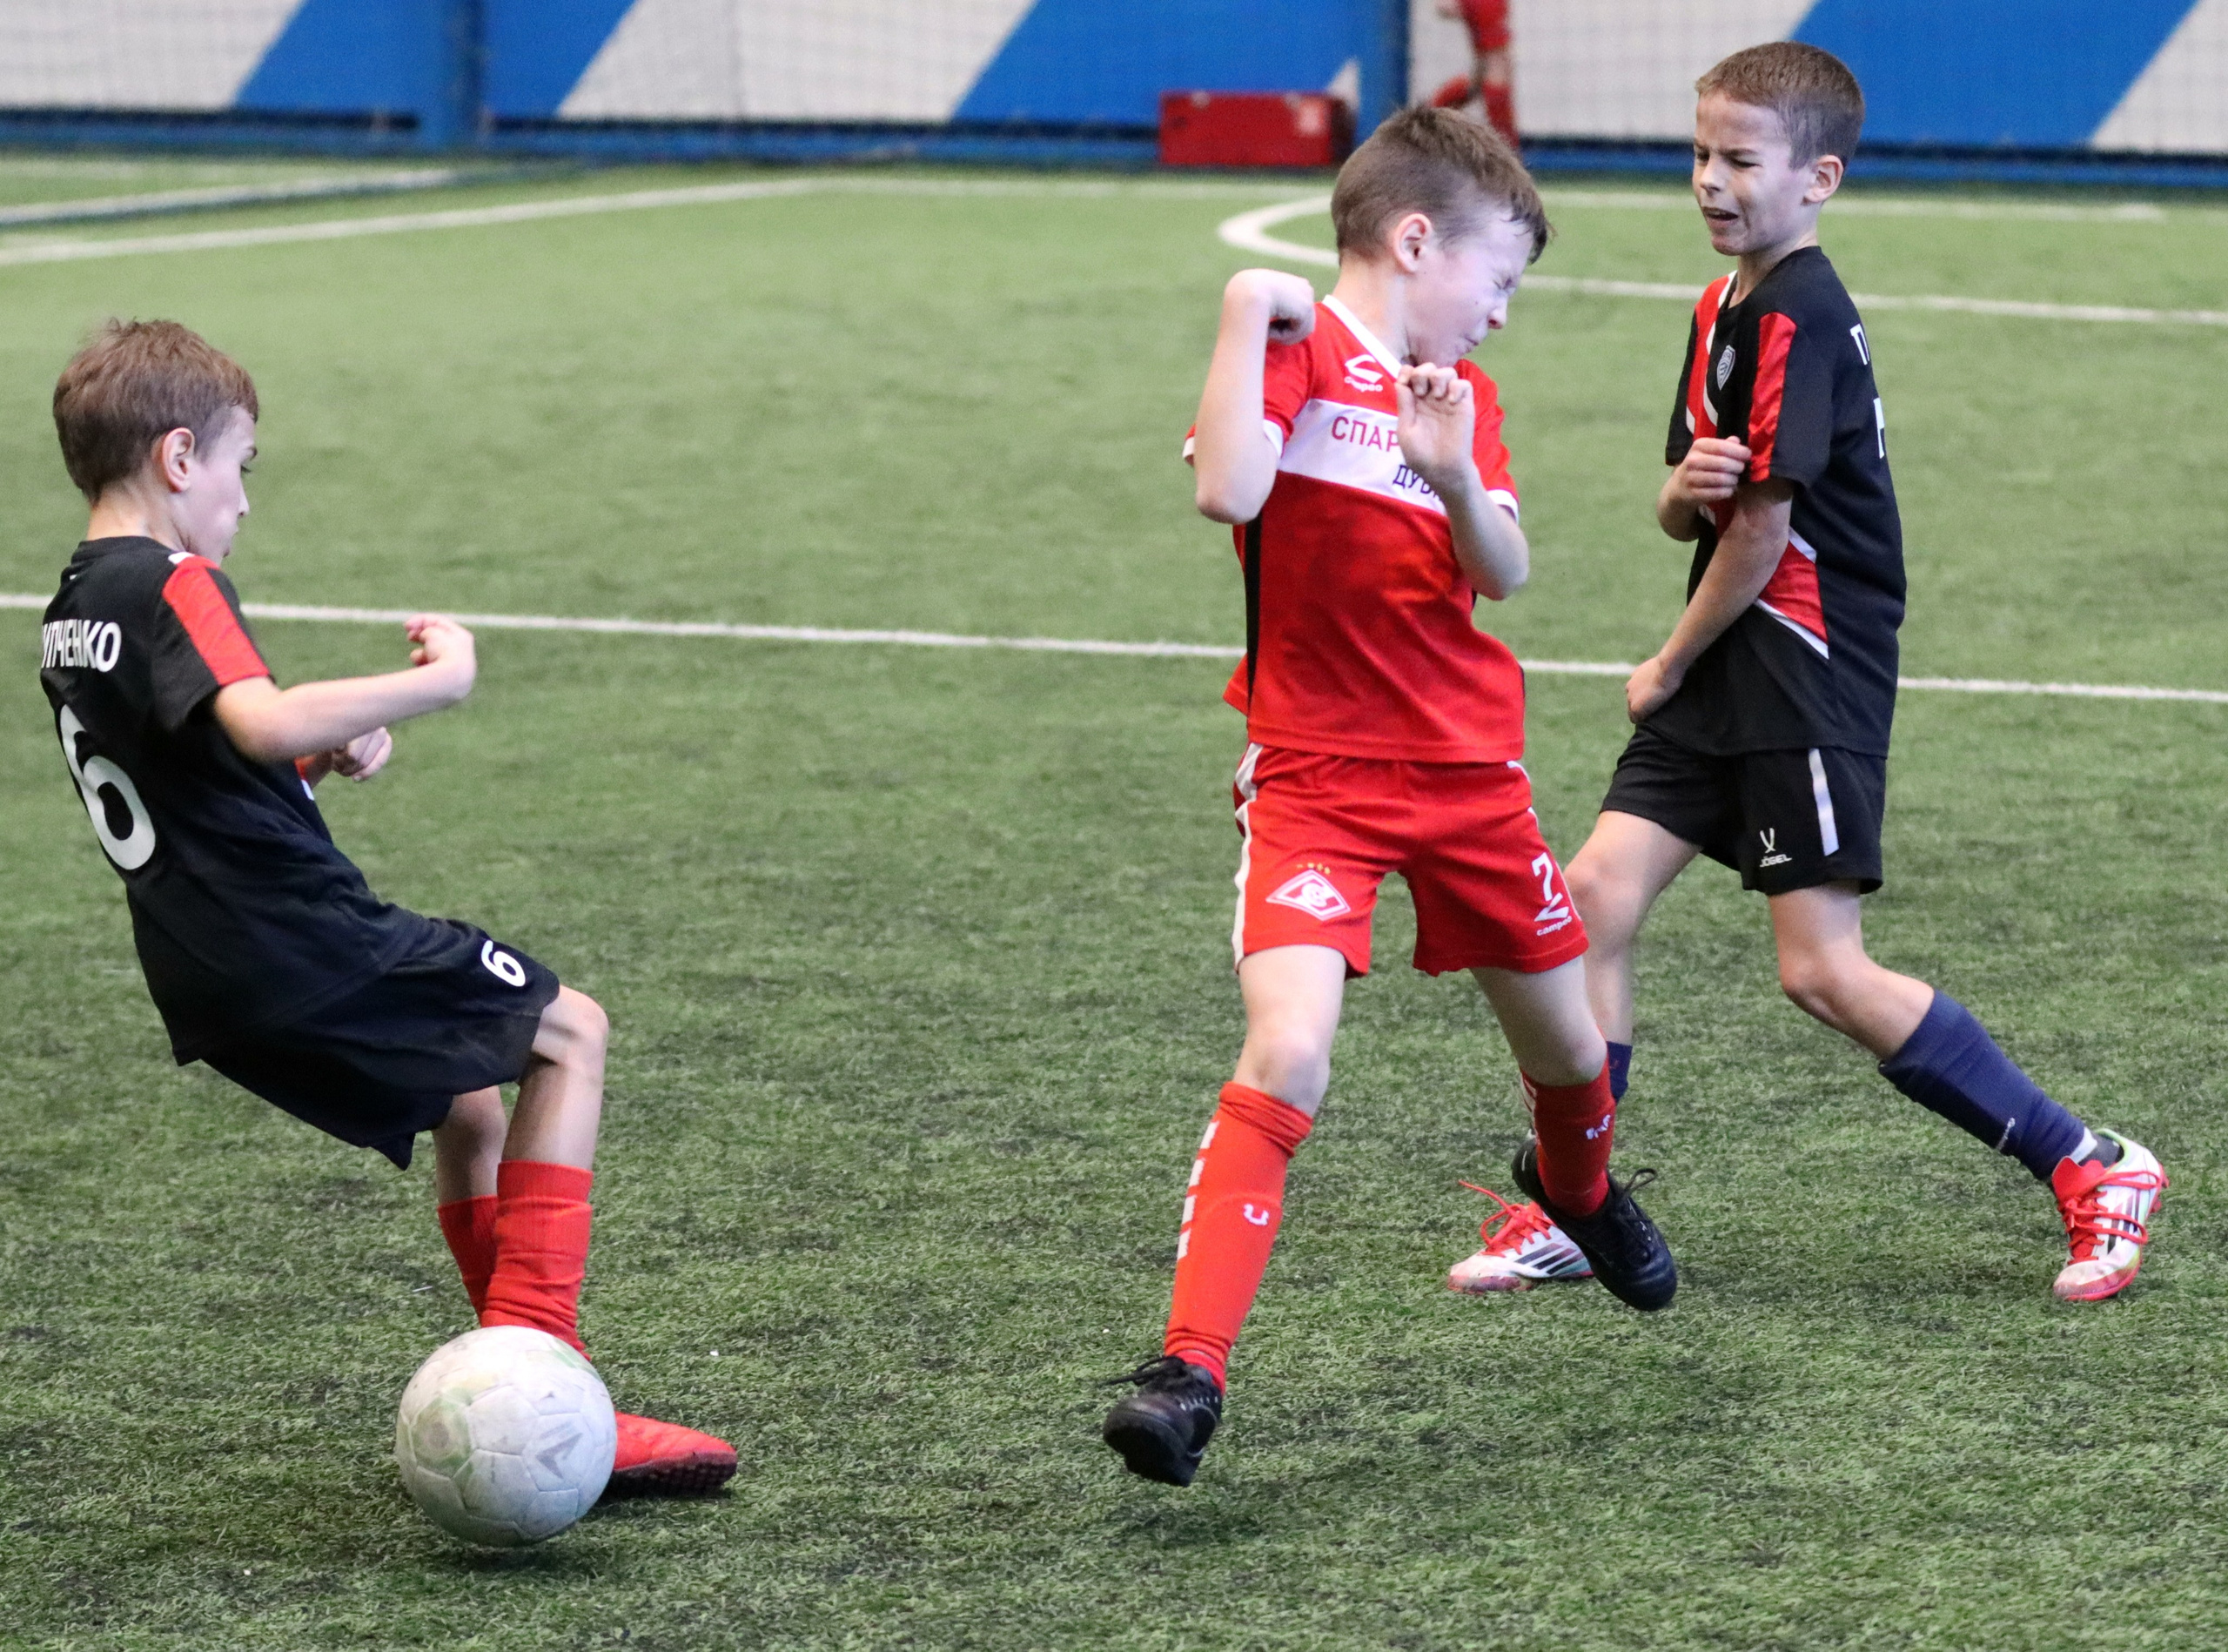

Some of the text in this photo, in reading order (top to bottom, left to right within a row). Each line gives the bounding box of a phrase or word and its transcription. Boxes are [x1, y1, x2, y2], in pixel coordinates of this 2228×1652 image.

[1331, 415, 1399, 453] СПАР
[41, 619, 122, 673] УПЧЕНКО
[60, 703, 156, 870] 6
[480, 939, 527, 987] 6
